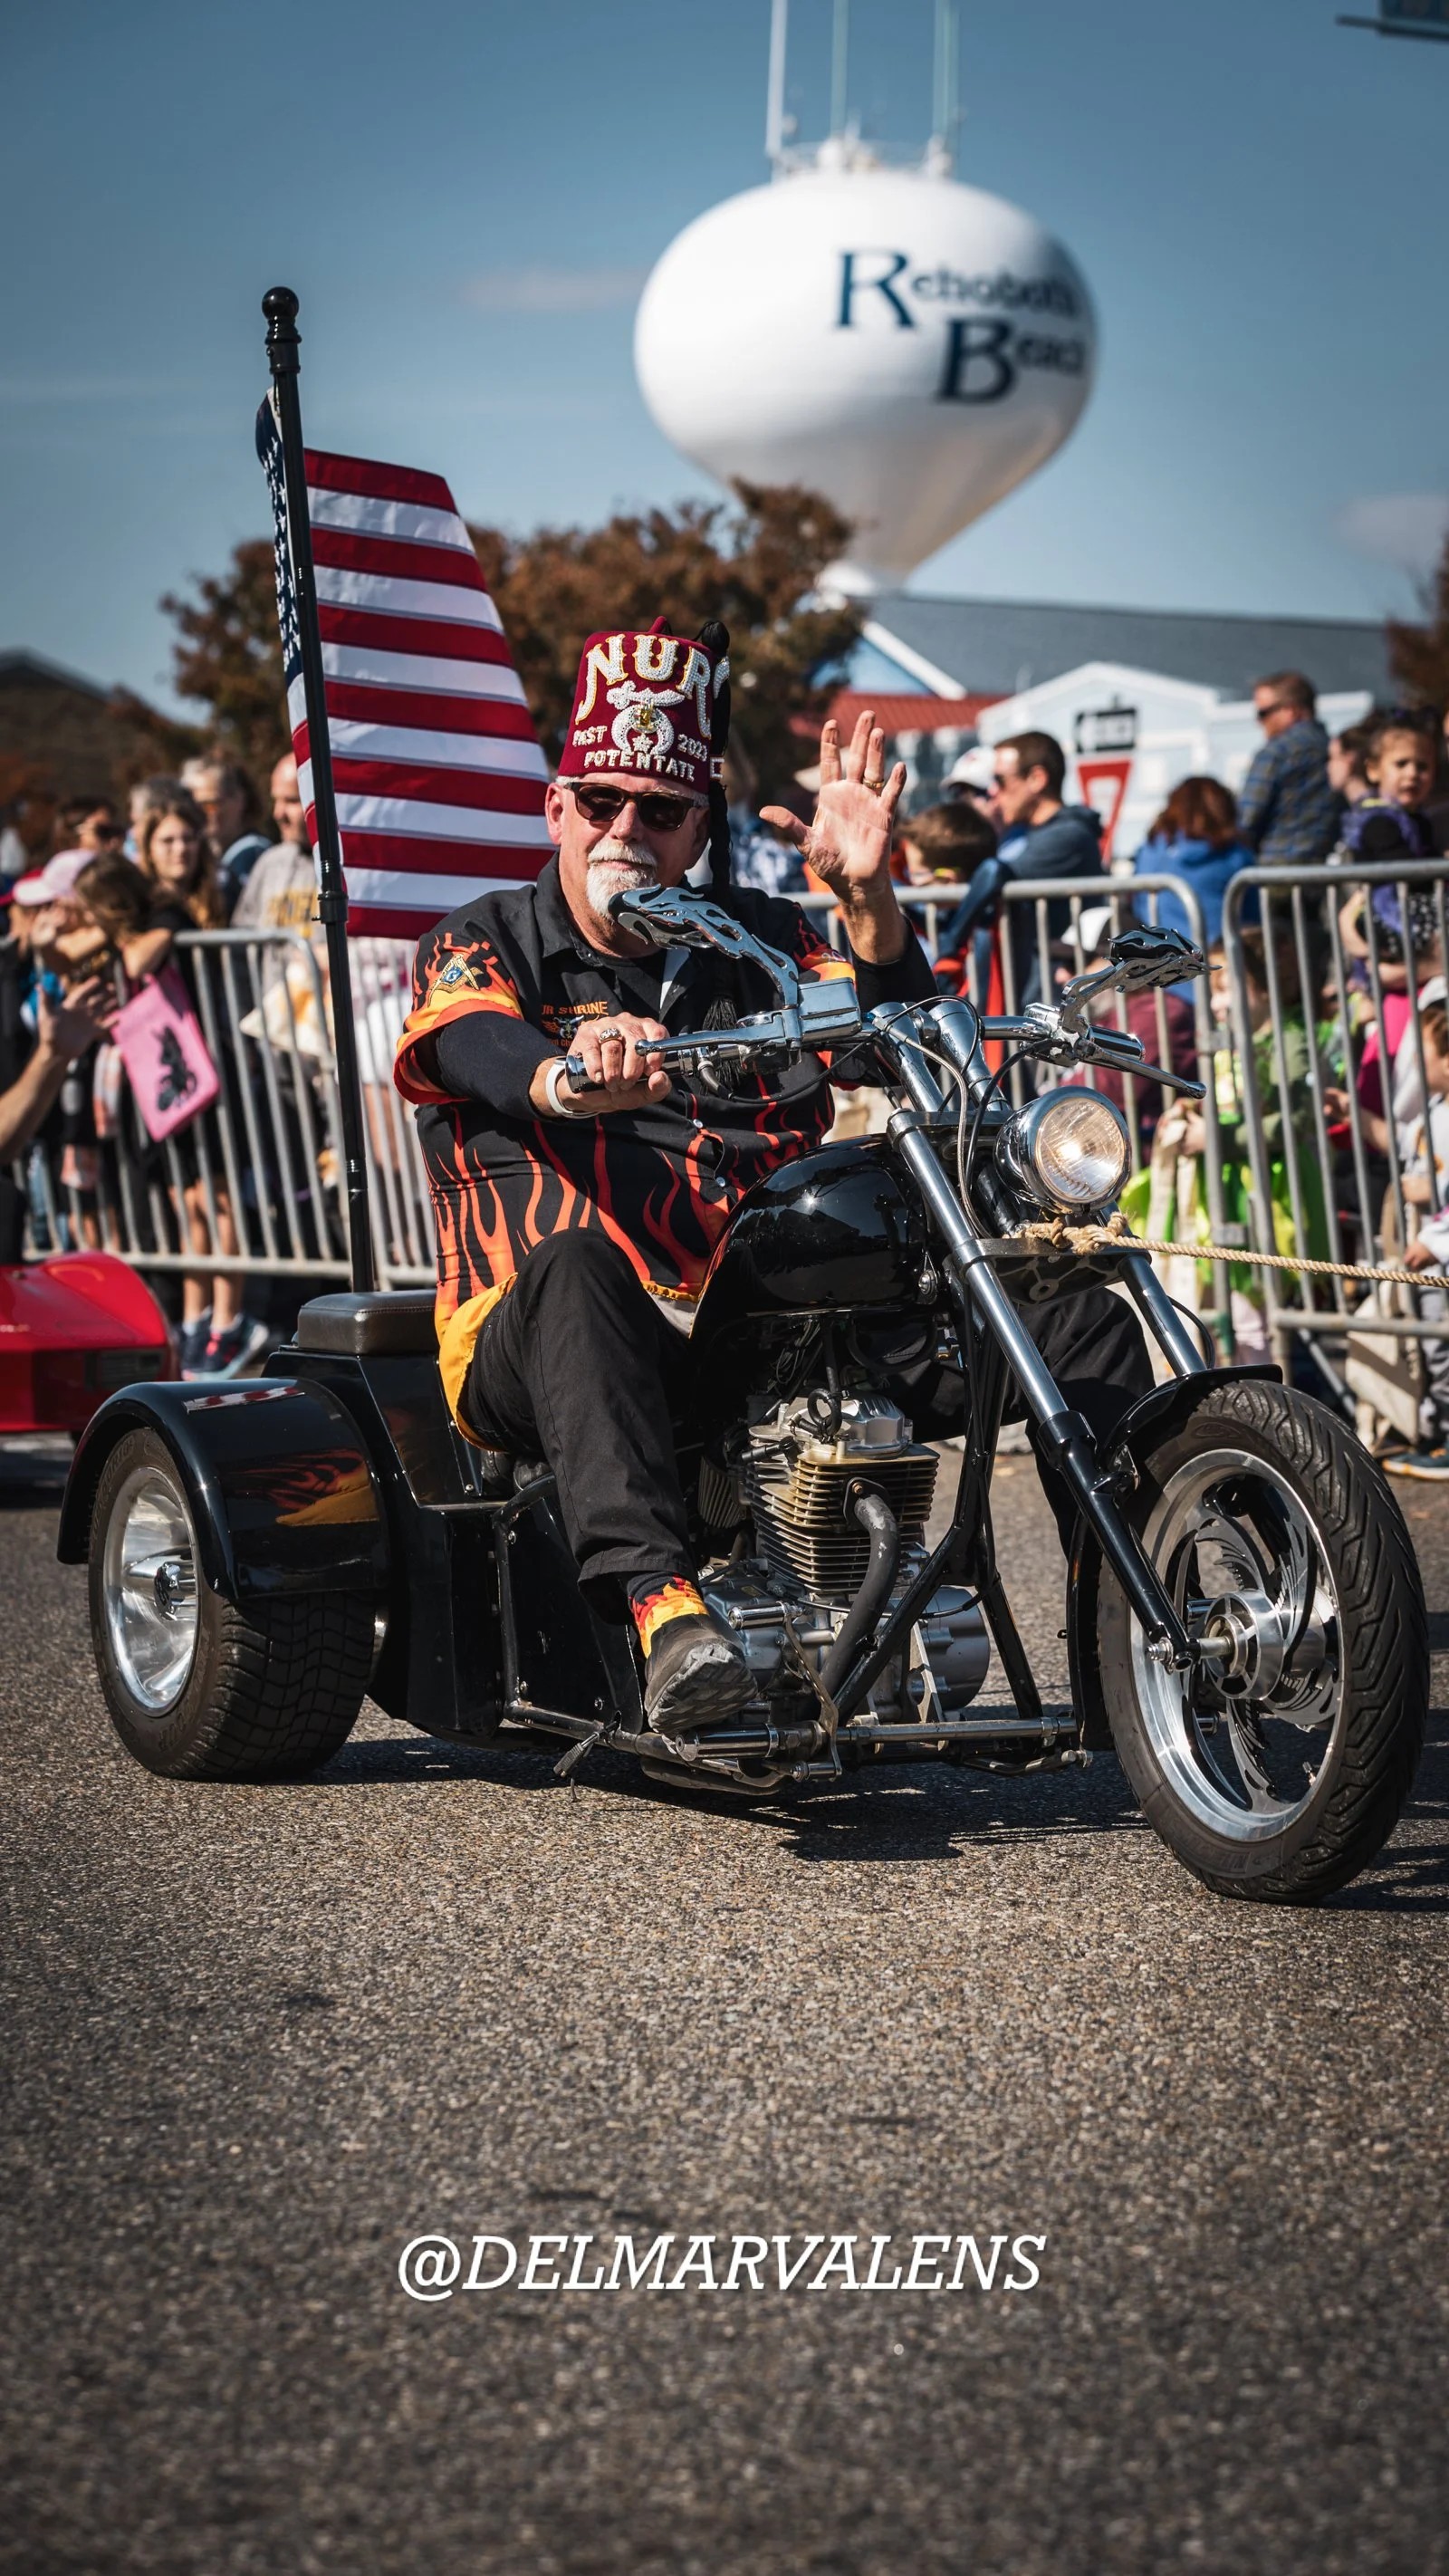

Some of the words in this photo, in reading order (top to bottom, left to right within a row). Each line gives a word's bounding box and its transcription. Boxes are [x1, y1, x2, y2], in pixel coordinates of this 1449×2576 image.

[575, 633, 712, 739] NUR
[572, 725, 607, 746] PAST
[584, 748, 696, 783] POTENTATE
[558, 1001, 609, 1015] SHRINE
